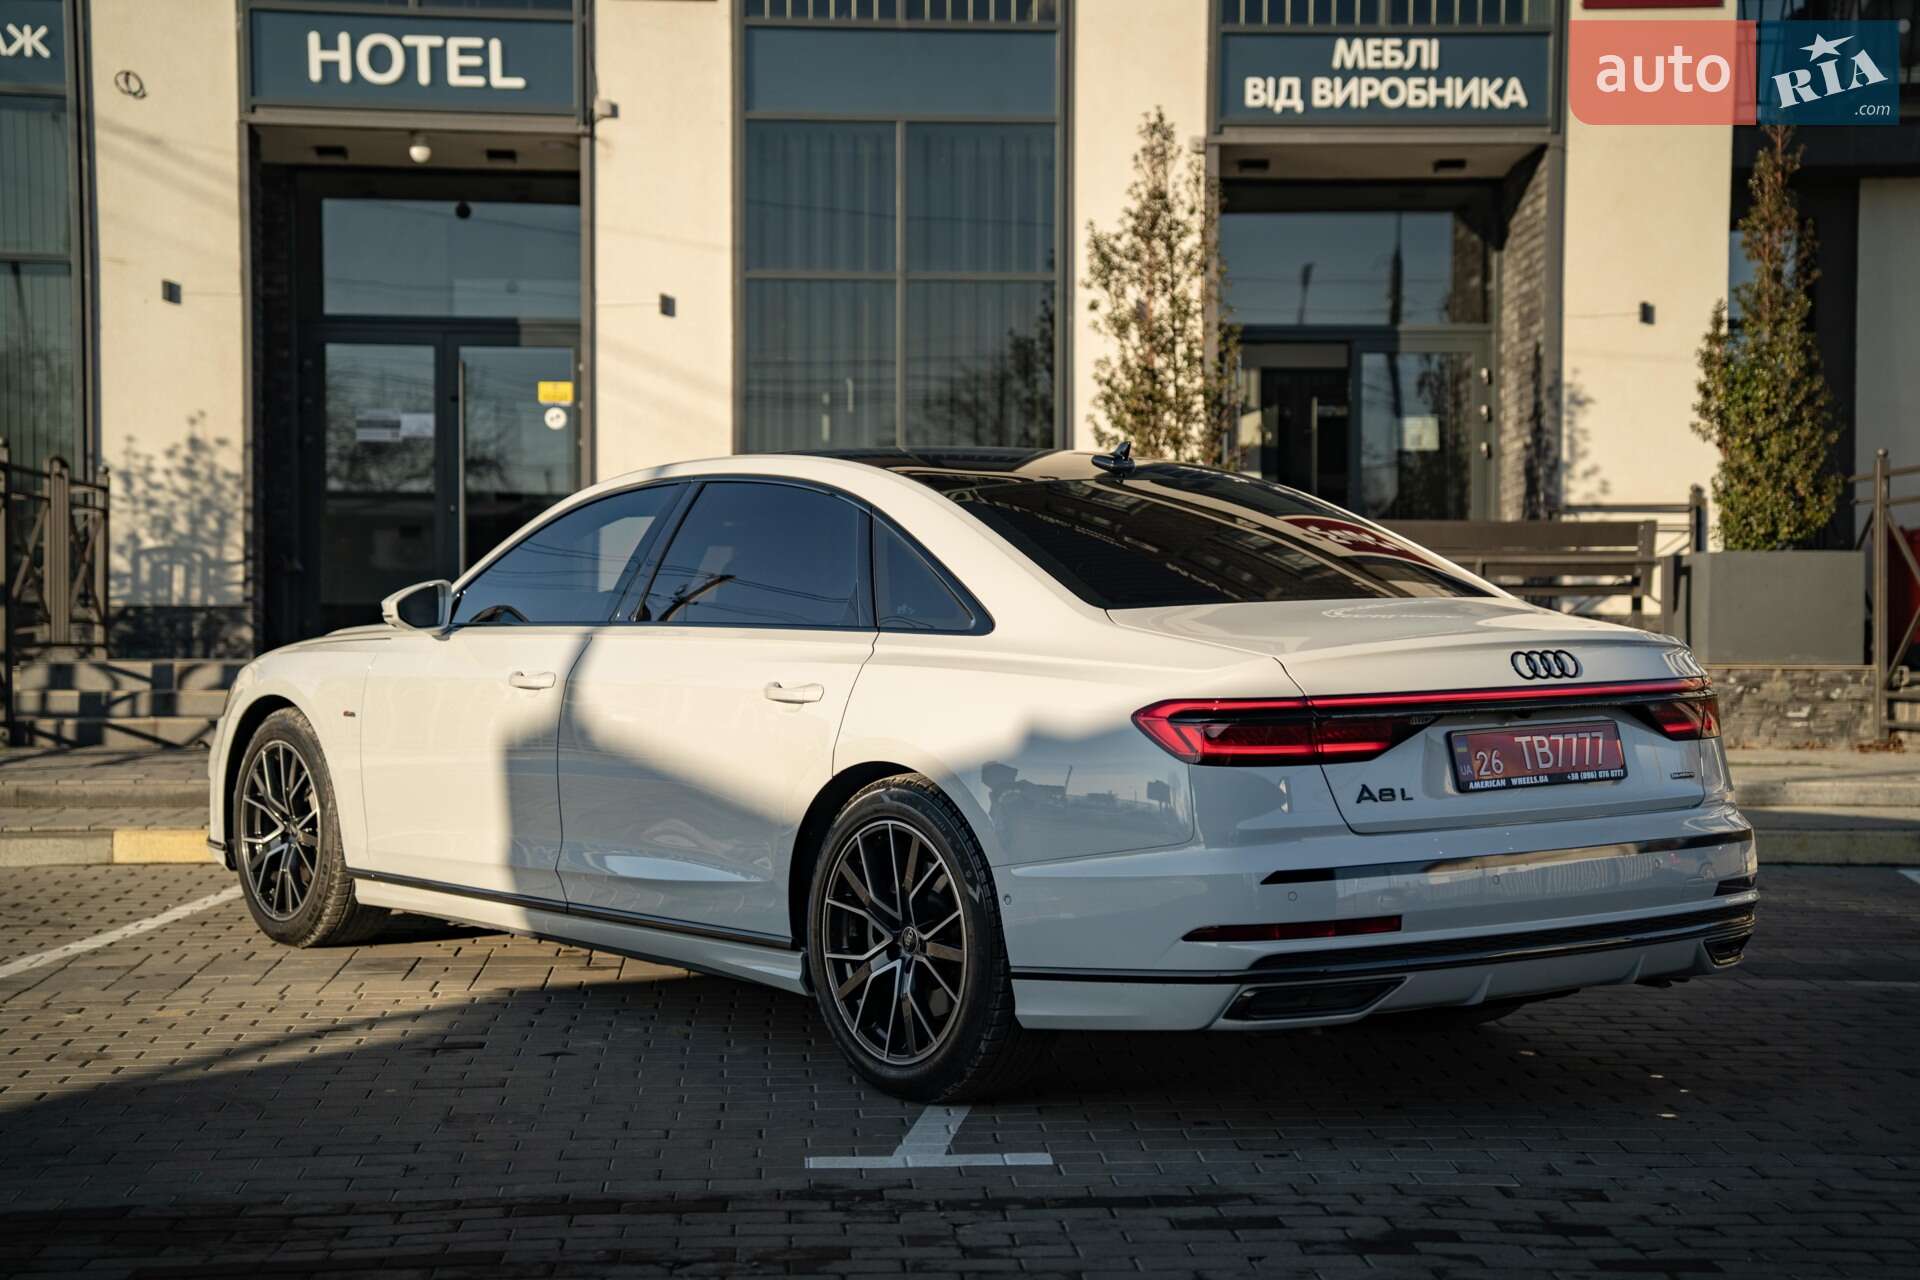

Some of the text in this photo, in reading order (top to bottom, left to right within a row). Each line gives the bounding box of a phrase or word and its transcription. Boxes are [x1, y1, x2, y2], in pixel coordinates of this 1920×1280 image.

[0, 23, 51, 58] Ж
[1331, 37, 1440, 70] МЕБЛІ
[307, 30, 527, 89] HOTEL
[1244, 76, 1528, 113] ВІД ВИРОБНИКА
[1460, 766, 1473, 776] UA
[1475, 731, 1604, 776] 26 TB7777
[1469, 778, 1506, 789] AMERICAN
[1510, 776, 1549, 786] WHEELS.UA
